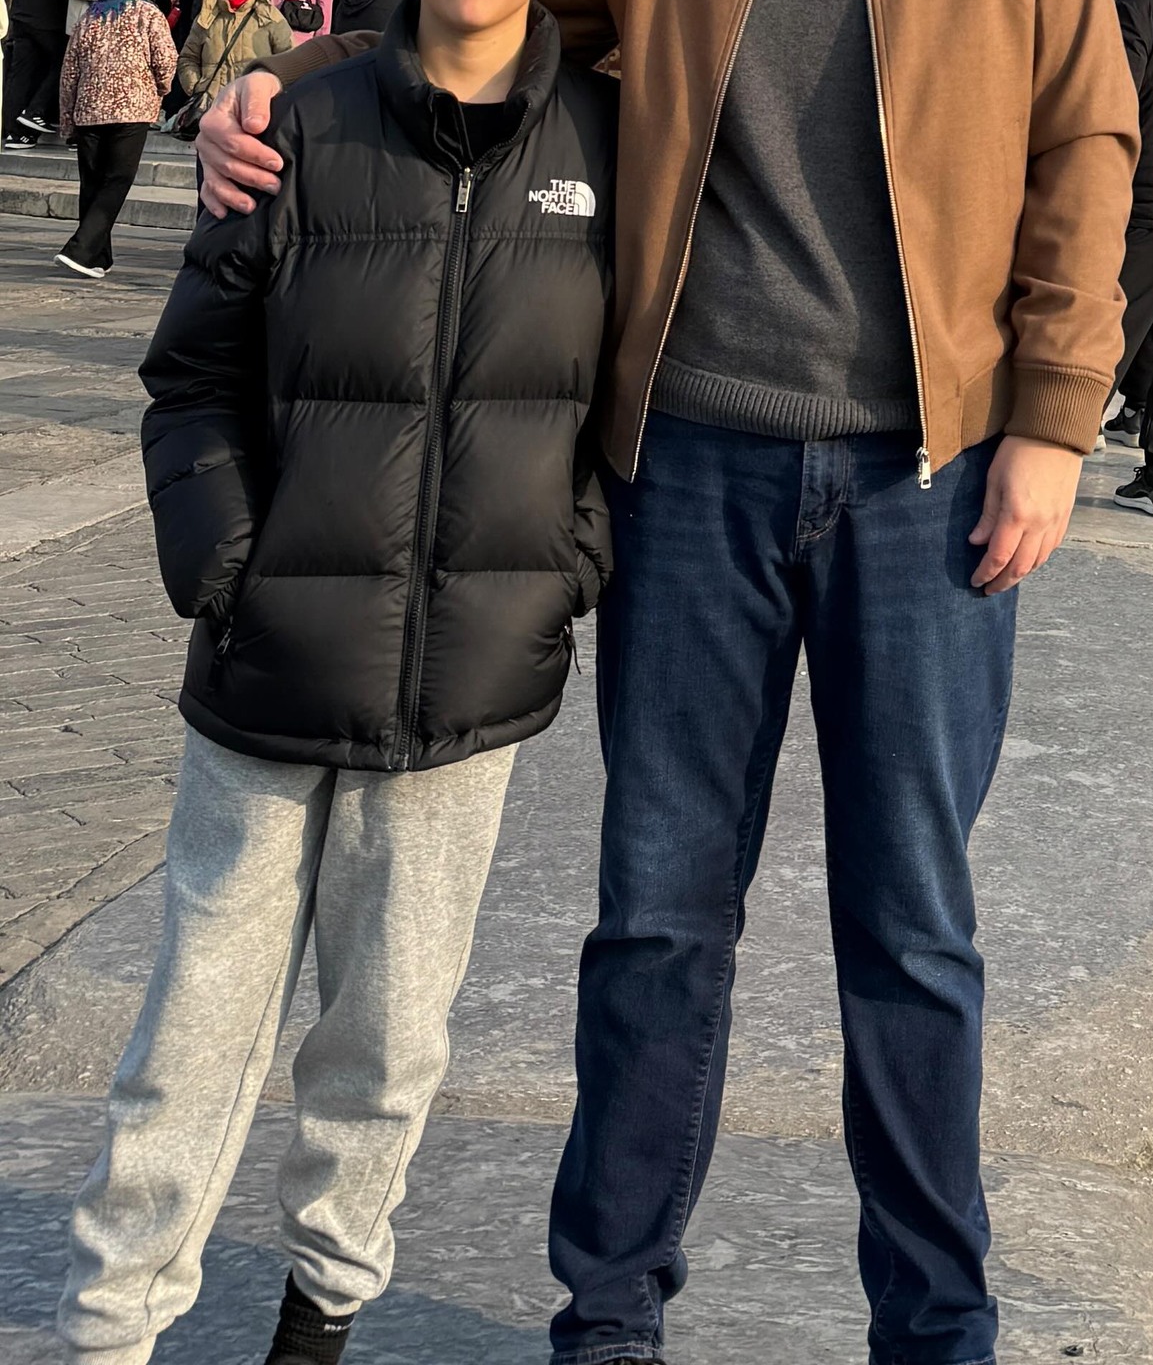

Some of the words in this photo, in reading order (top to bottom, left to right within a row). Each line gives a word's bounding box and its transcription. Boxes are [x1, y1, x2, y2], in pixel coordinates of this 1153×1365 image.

[550, 179, 576, 192] THE
[528, 190, 575, 204] NORTH
[541, 202, 575, 215] FACE
